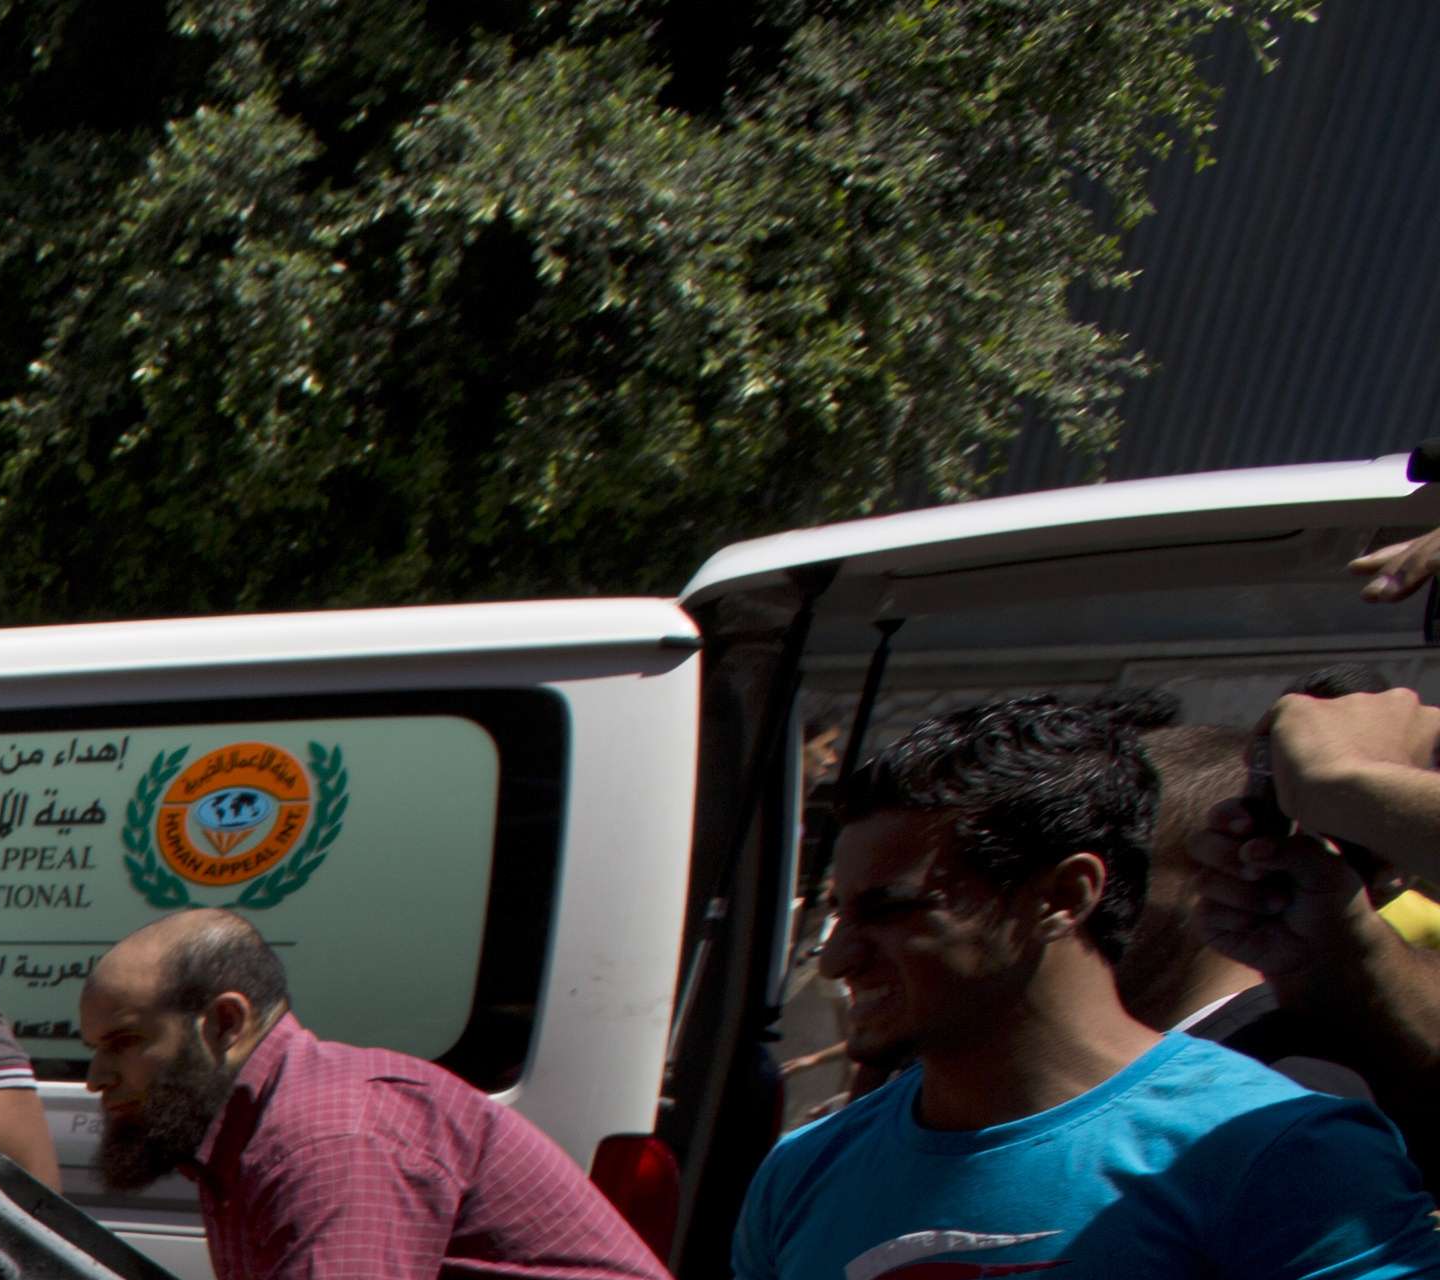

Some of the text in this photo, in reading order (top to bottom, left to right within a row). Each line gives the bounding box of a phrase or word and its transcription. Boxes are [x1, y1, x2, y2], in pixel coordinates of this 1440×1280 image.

[53, 735, 130, 771] إهداء
[165, 811, 202, 873] HUMAN
[203, 846, 279, 878] APPEAL
